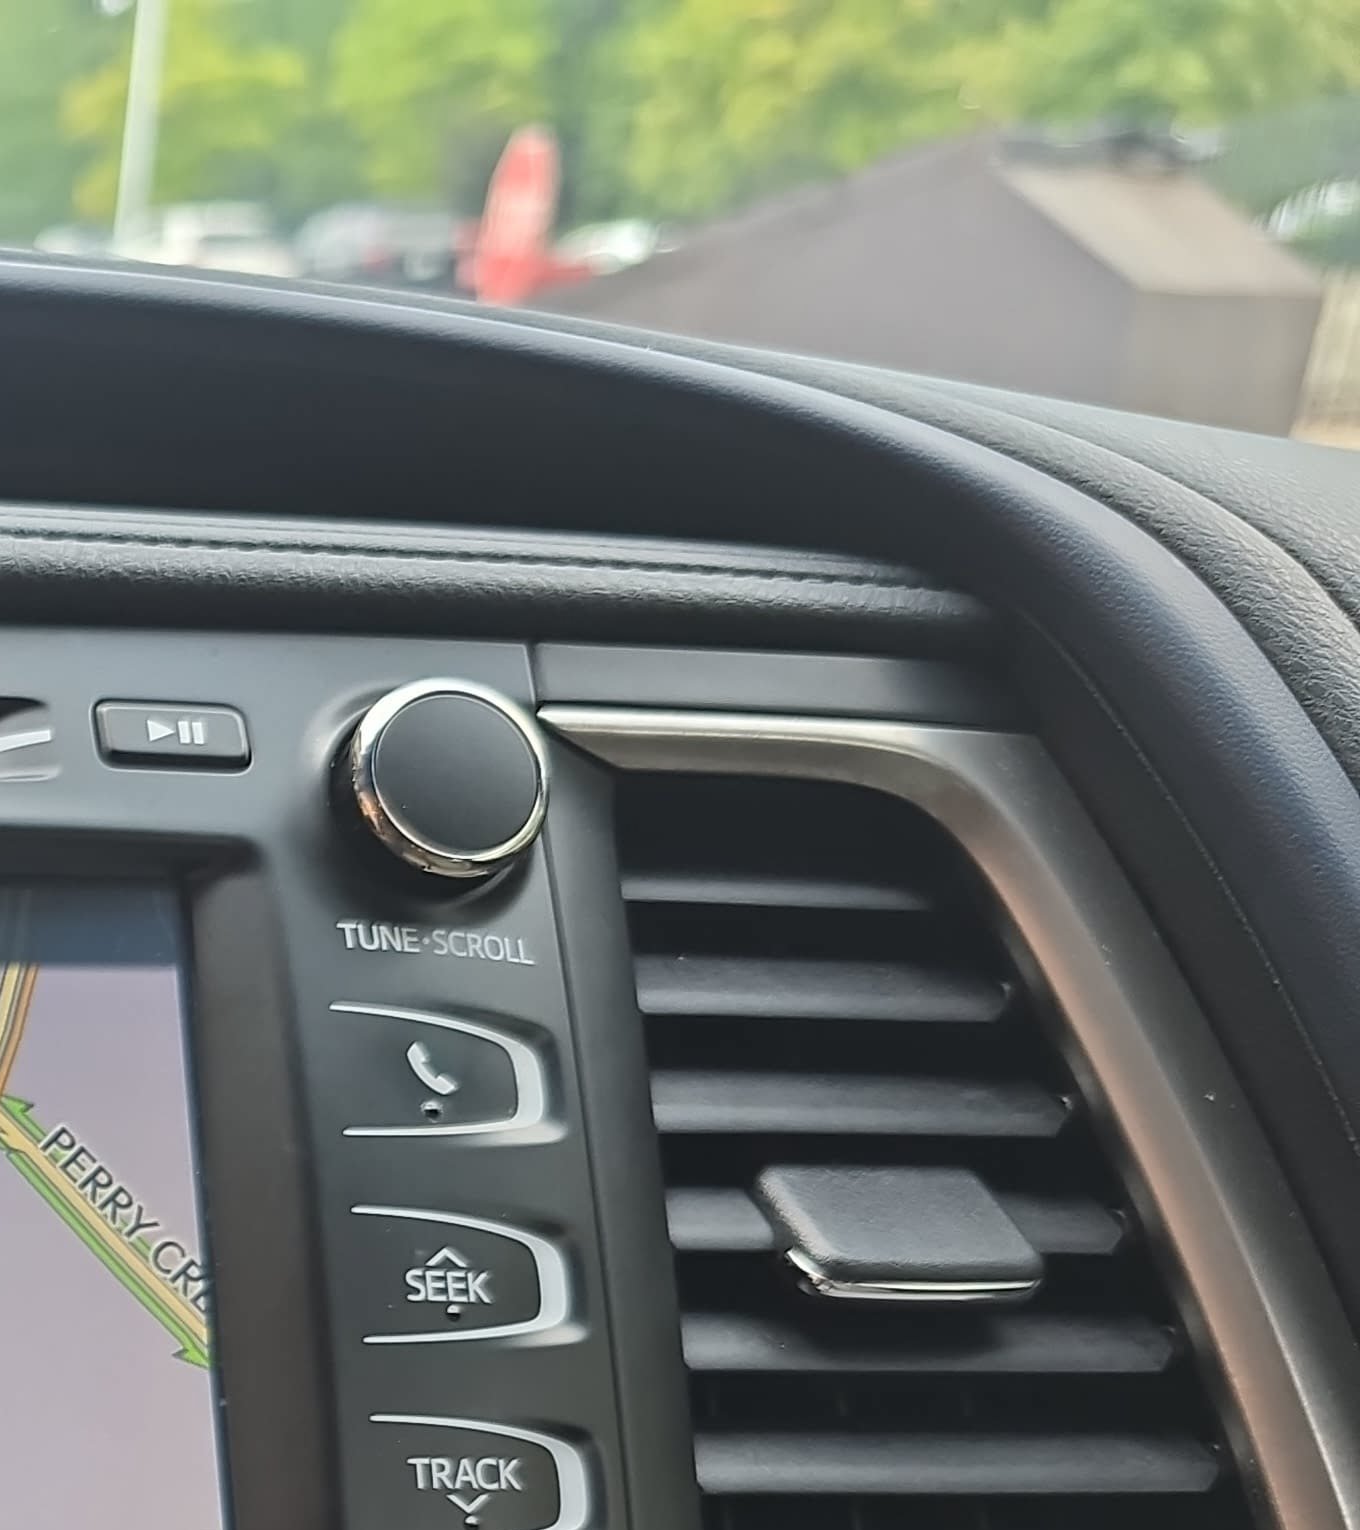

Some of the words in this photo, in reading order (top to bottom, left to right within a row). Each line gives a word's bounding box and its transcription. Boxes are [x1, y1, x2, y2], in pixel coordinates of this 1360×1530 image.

[40, 1127, 160, 1239] PERRY
[405, 1269, 492, 1303] SEEK
[407, 1458, 523, 1490] TRACK
